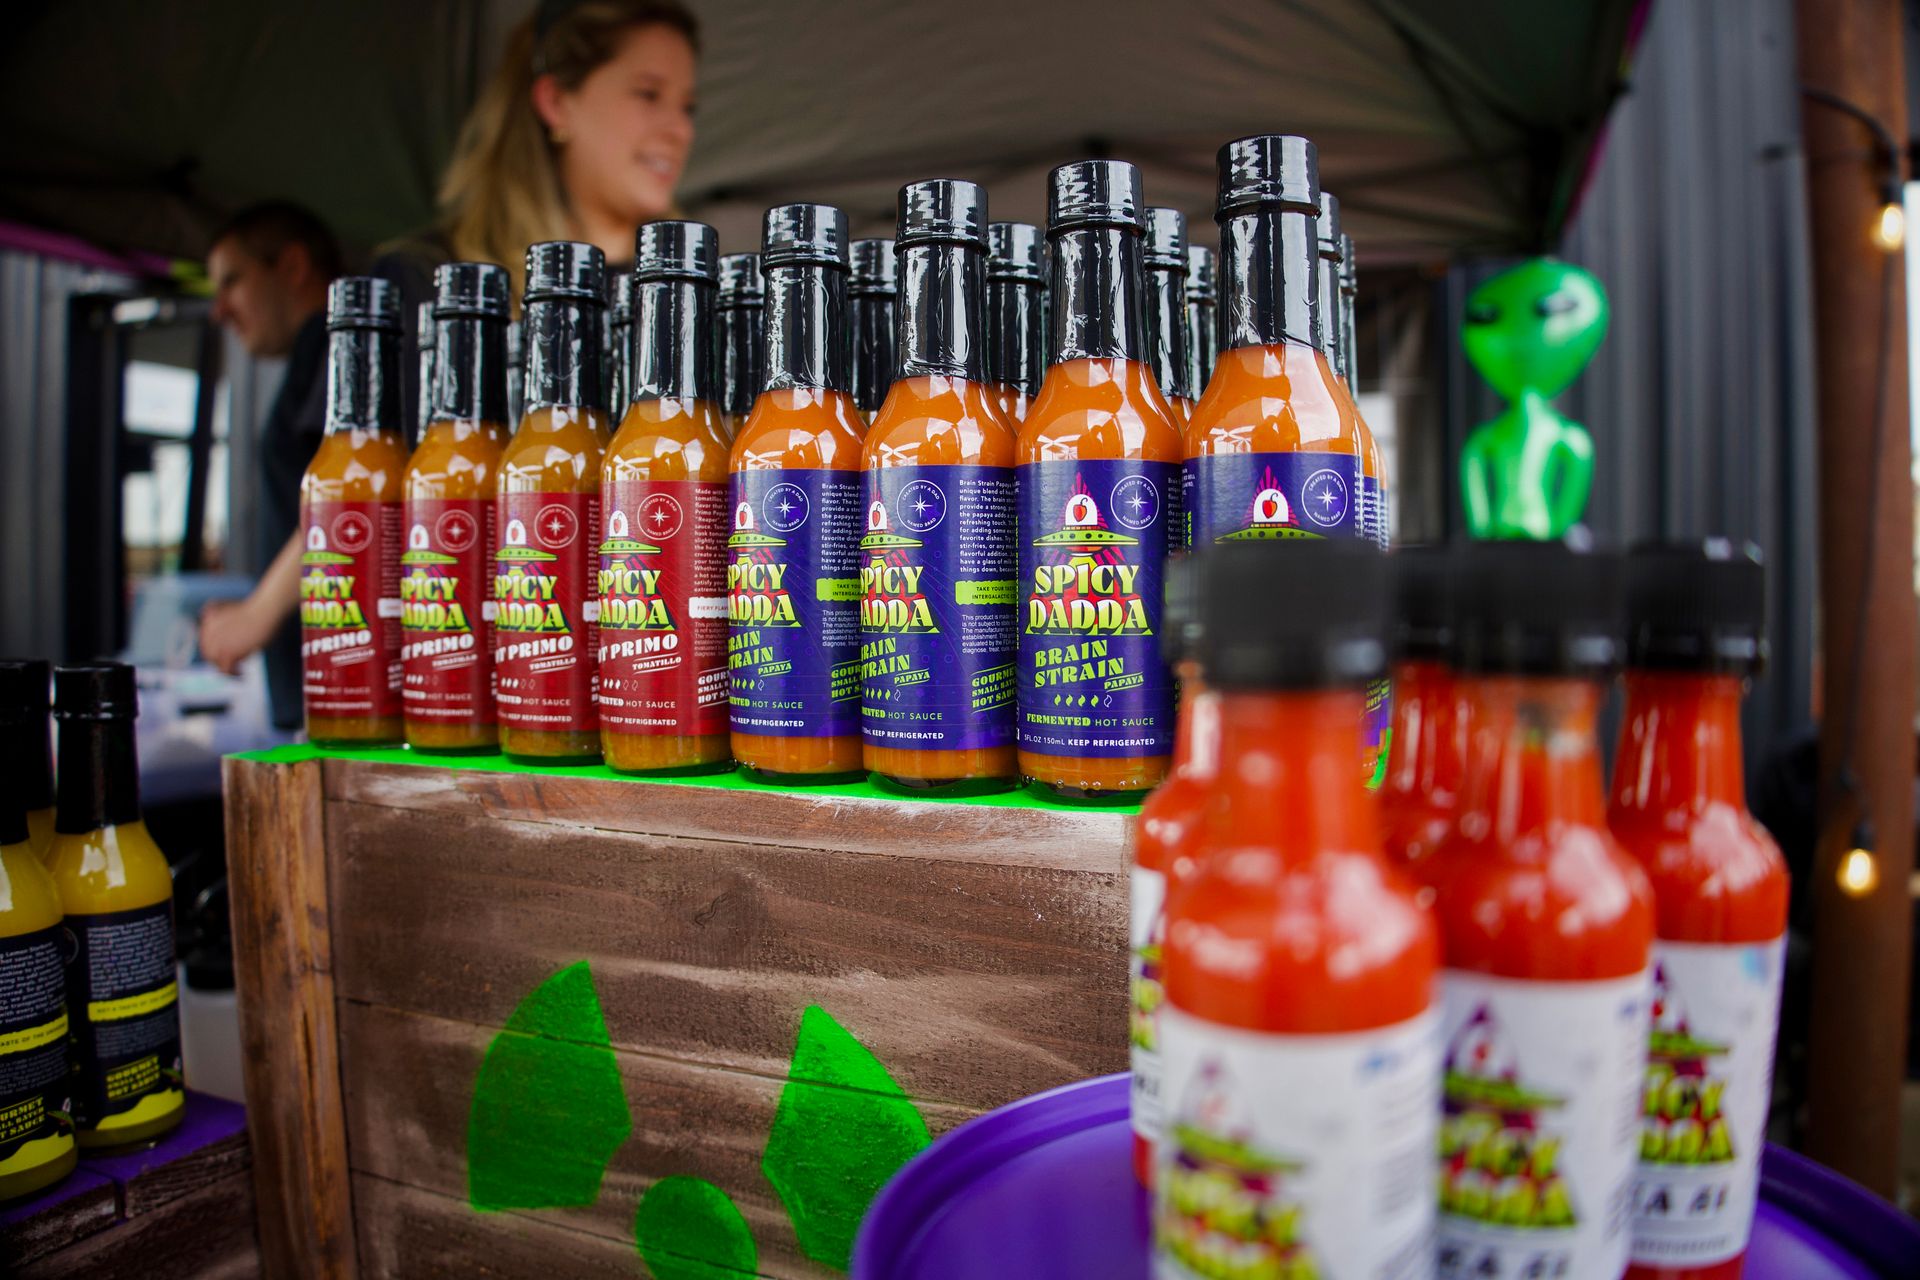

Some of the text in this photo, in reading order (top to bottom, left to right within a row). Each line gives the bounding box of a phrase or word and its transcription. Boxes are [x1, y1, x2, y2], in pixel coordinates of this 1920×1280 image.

[768, 488, 784, 502] CREATED
[795, 492, 804, 502] DAD
[902, 485, 919, 500] CREATED
[931, 489, 940, 500] DAD
[1117, 480, 1136, 496] CREATED
[1147, 486, 1155, 497] DAD
[906, 517, 937, 528] NAMED BRAD
[960, 519, 990, 527] refreshing
[1122, 514, 1152, 526] NAMED BRAD
[1035, 563, 1140, 595] SPICY
[301, 600, 368, 629] ADDA
[401, 602, 472, 632] ADDA
[598, 599, 677, 631] ADDA
[727, 594, 799, 626] ADDA
[861, 598, 937, 631] ADDA
[1027, 598, 1151, 634] DADDA
[495, 602, 570, 633] ADDA
[412, 633, 475, 659] PRIMO
[507, 635, 573, 661] PRIMO
[610, 633, 678, 660] PRIMO
[728, 630, 760, 653] RAIN
[1035, 640, 1107, 668] BRAIN
[632, 656, 682, 671] TOMATILLO
[757, 662, 792, 675] PAPAYA
[697, 671, 729, 685] GOUR
[830, 665, 860, 679] GOUR
[893, 670, 930, 685] PAPAYA
[1034, 657, 1124, 688] STRAIN
[1104, 674, 1144, 690] PAPAYA
[698, 691, 718, 704] HOT
[831, 686, 852, 698] HOT
[972, 685, 999, 698] SMALL
[542, 698, 571, 706] SAUCE
[626, 700, 676, 709] HOT SAUCE
[752, 700, 803, 709] HOT SAUCE
[972, 695, 994, 708] HOT
[625, 717, 677, 726] REFRIGERATED
[737, 717, 750, 725] KEEP
[751, 719, 805, 727] REFRIGERATED
[909, 712, 943, 720] SAUCE
[1027, 713, 1154, 726] FERMENTED HOT SAUCE
[887, 731, 944, 739] REFRIGERATED
[1068, 739, 1090, 747] KEEP
[1093, 738, 1155, 747] REFRIGERATED
[0, 1096, 43, 1121] URMET
